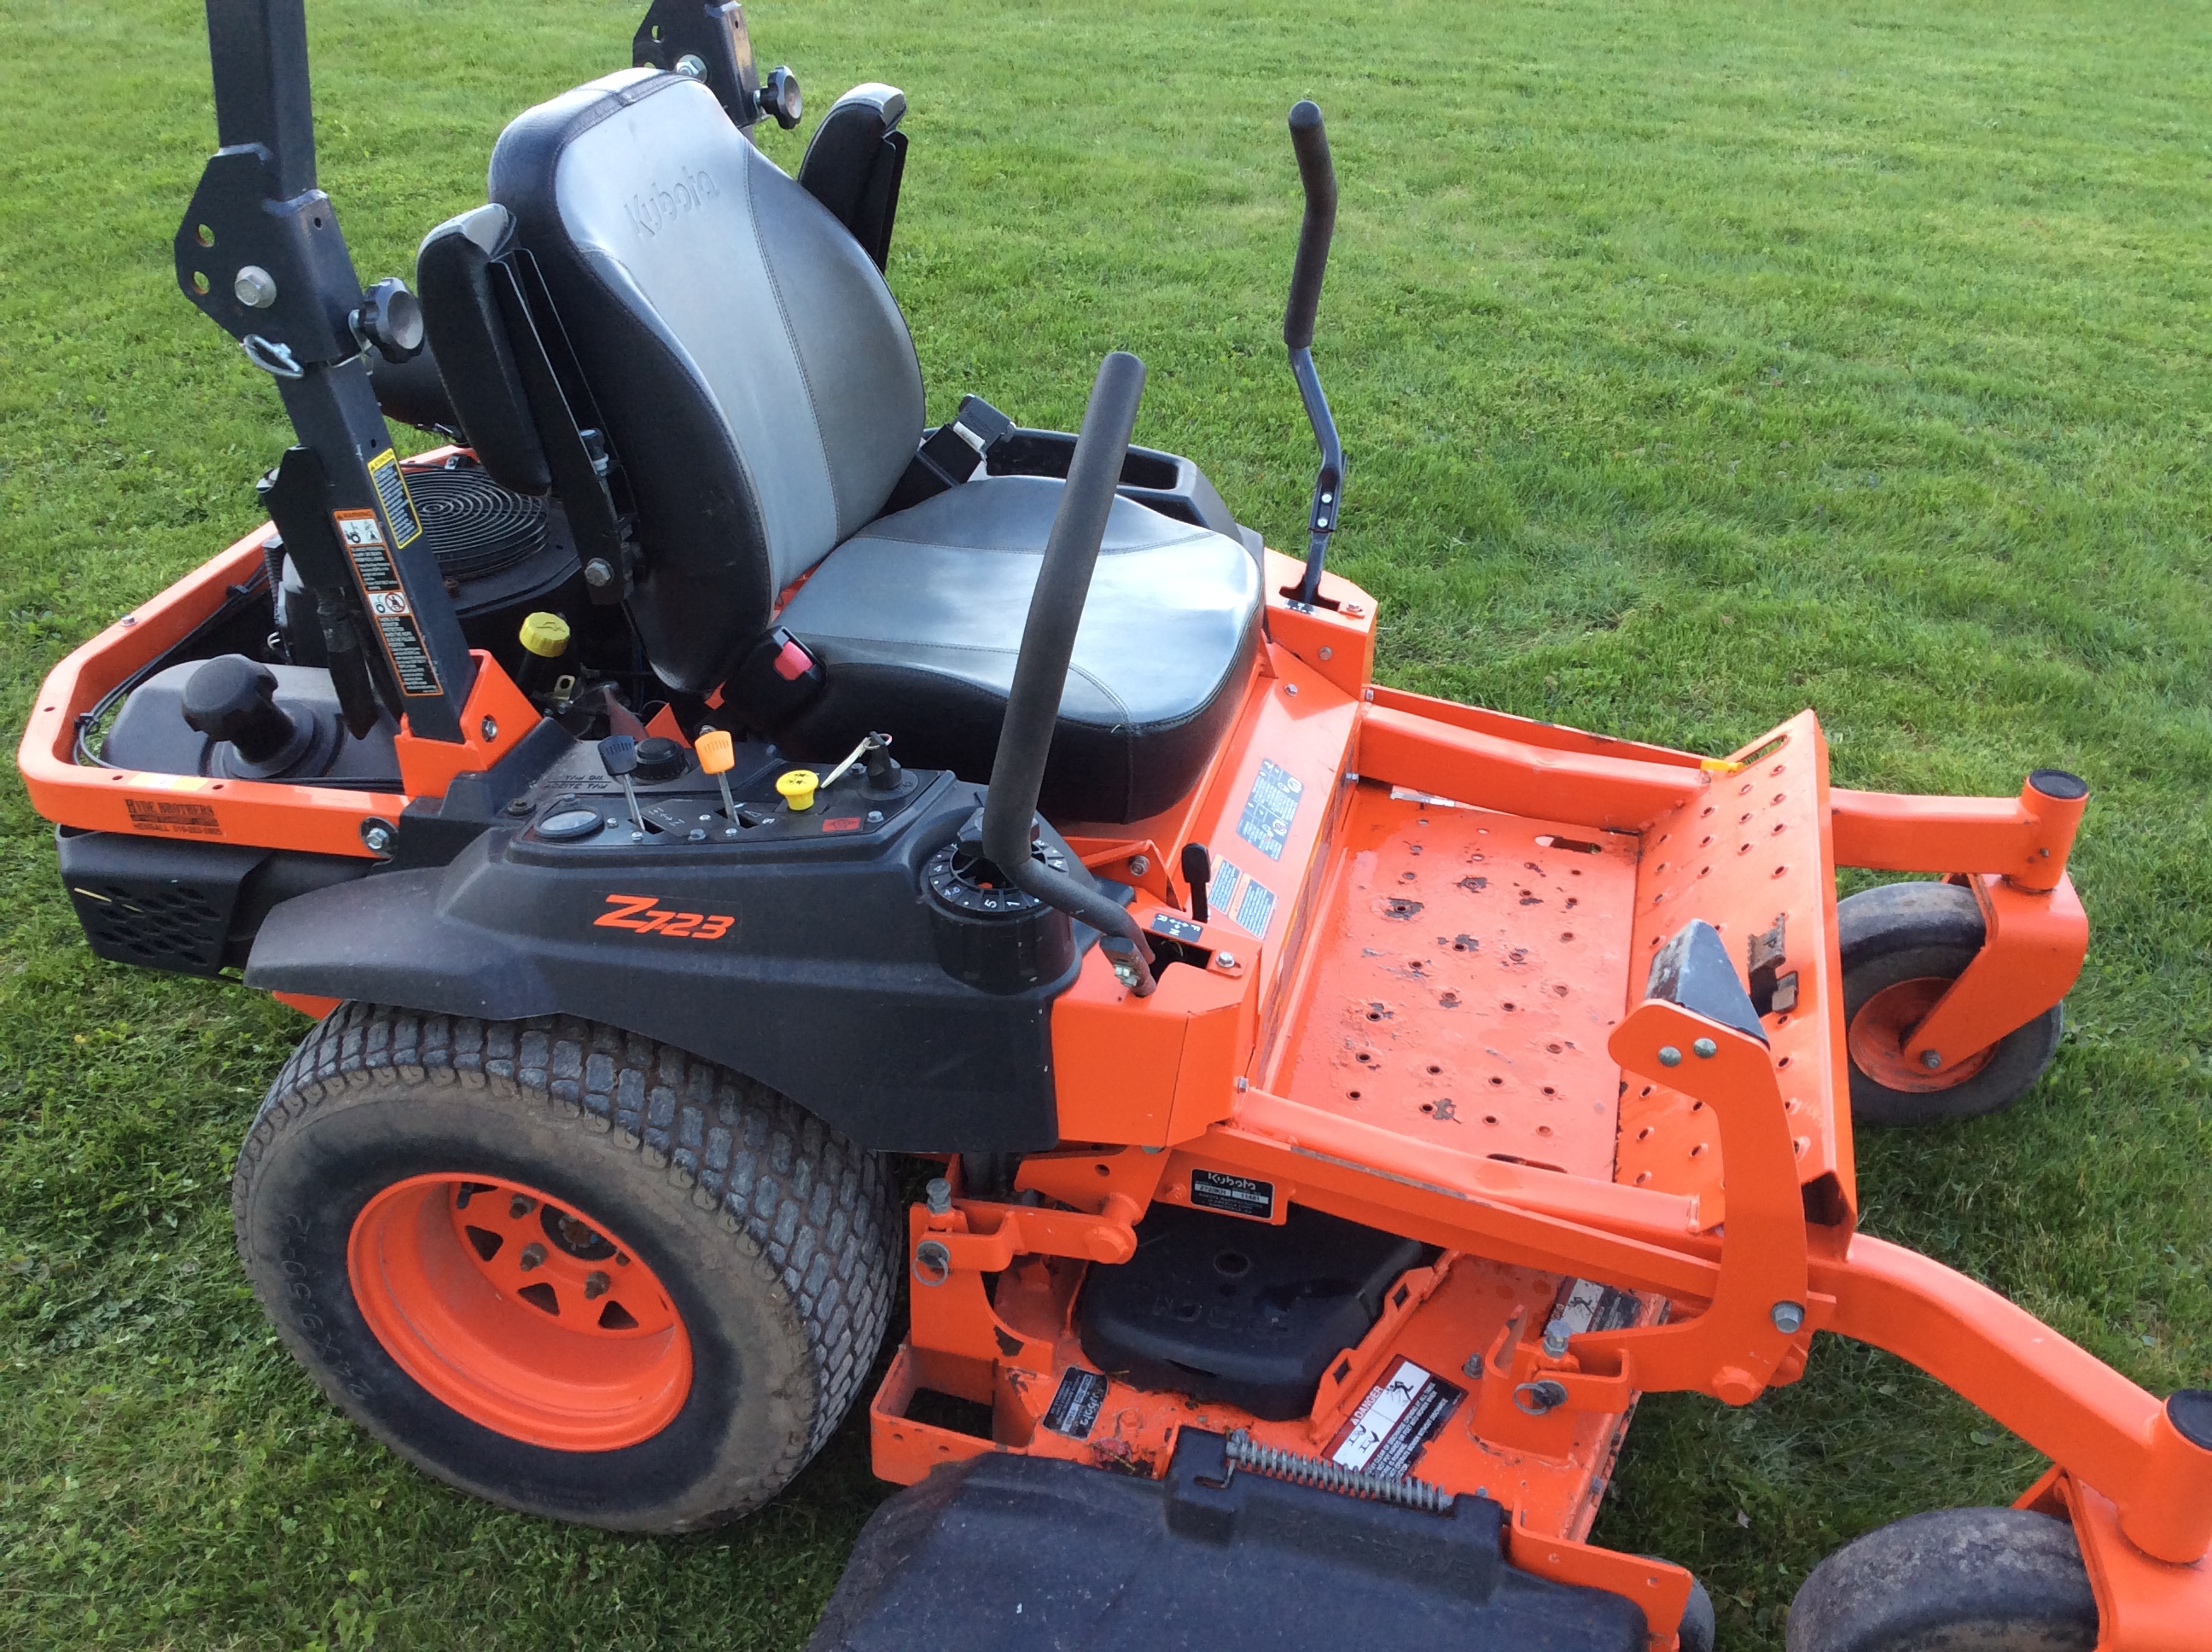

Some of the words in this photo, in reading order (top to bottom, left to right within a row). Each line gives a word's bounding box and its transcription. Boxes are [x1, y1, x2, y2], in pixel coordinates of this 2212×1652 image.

[624, 166, 719, 238] Kubota
[593, 894, 735, 939] Z723
[984, 899, 998, 909] 5
[1208, 1172, 1255, 1190] Kubota
[1356, 1385, 1383, 1419] DANGER
[1374, 1449, 1387, 1464] CLEAR
[1418, 1393, 1428, 1403] ALL
[1382, 1453, 1392, 1463] PUT
